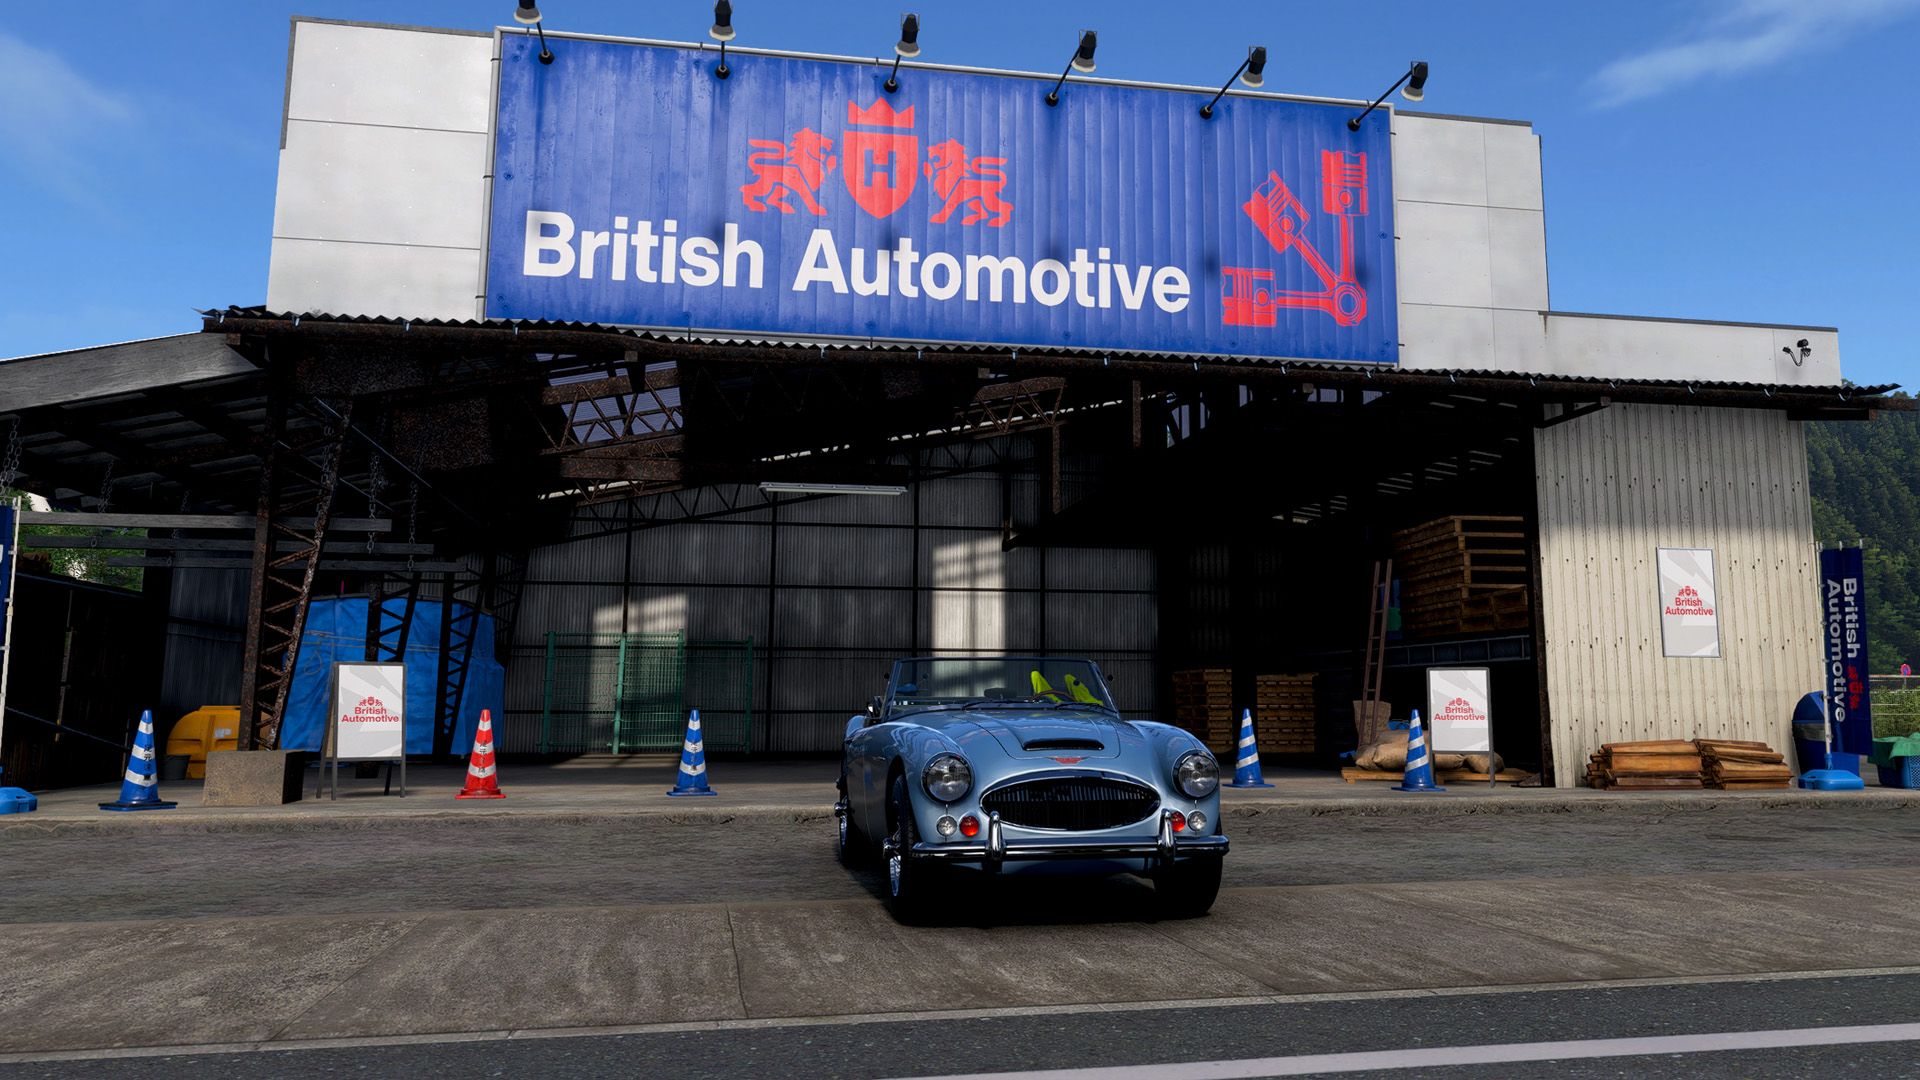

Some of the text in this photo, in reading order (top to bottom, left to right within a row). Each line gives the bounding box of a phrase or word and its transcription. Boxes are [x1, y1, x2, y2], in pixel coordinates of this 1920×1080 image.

[863, 149, 897, 189] H
[522, 210, 1192, 313] British Automotive
[1675, 597, 1703, 607] British
[1665, 606, 1713, 616] Automotive
[1843, 577, 1860, 658] British
[1827, 579, 1847, 723] Automotive
[354, 706, 387, 715] British
[1445, 706, 1474, 714] British
[341, 714, 399, 722] Automotive
[1434, 713, 1485, 721] Automotive
